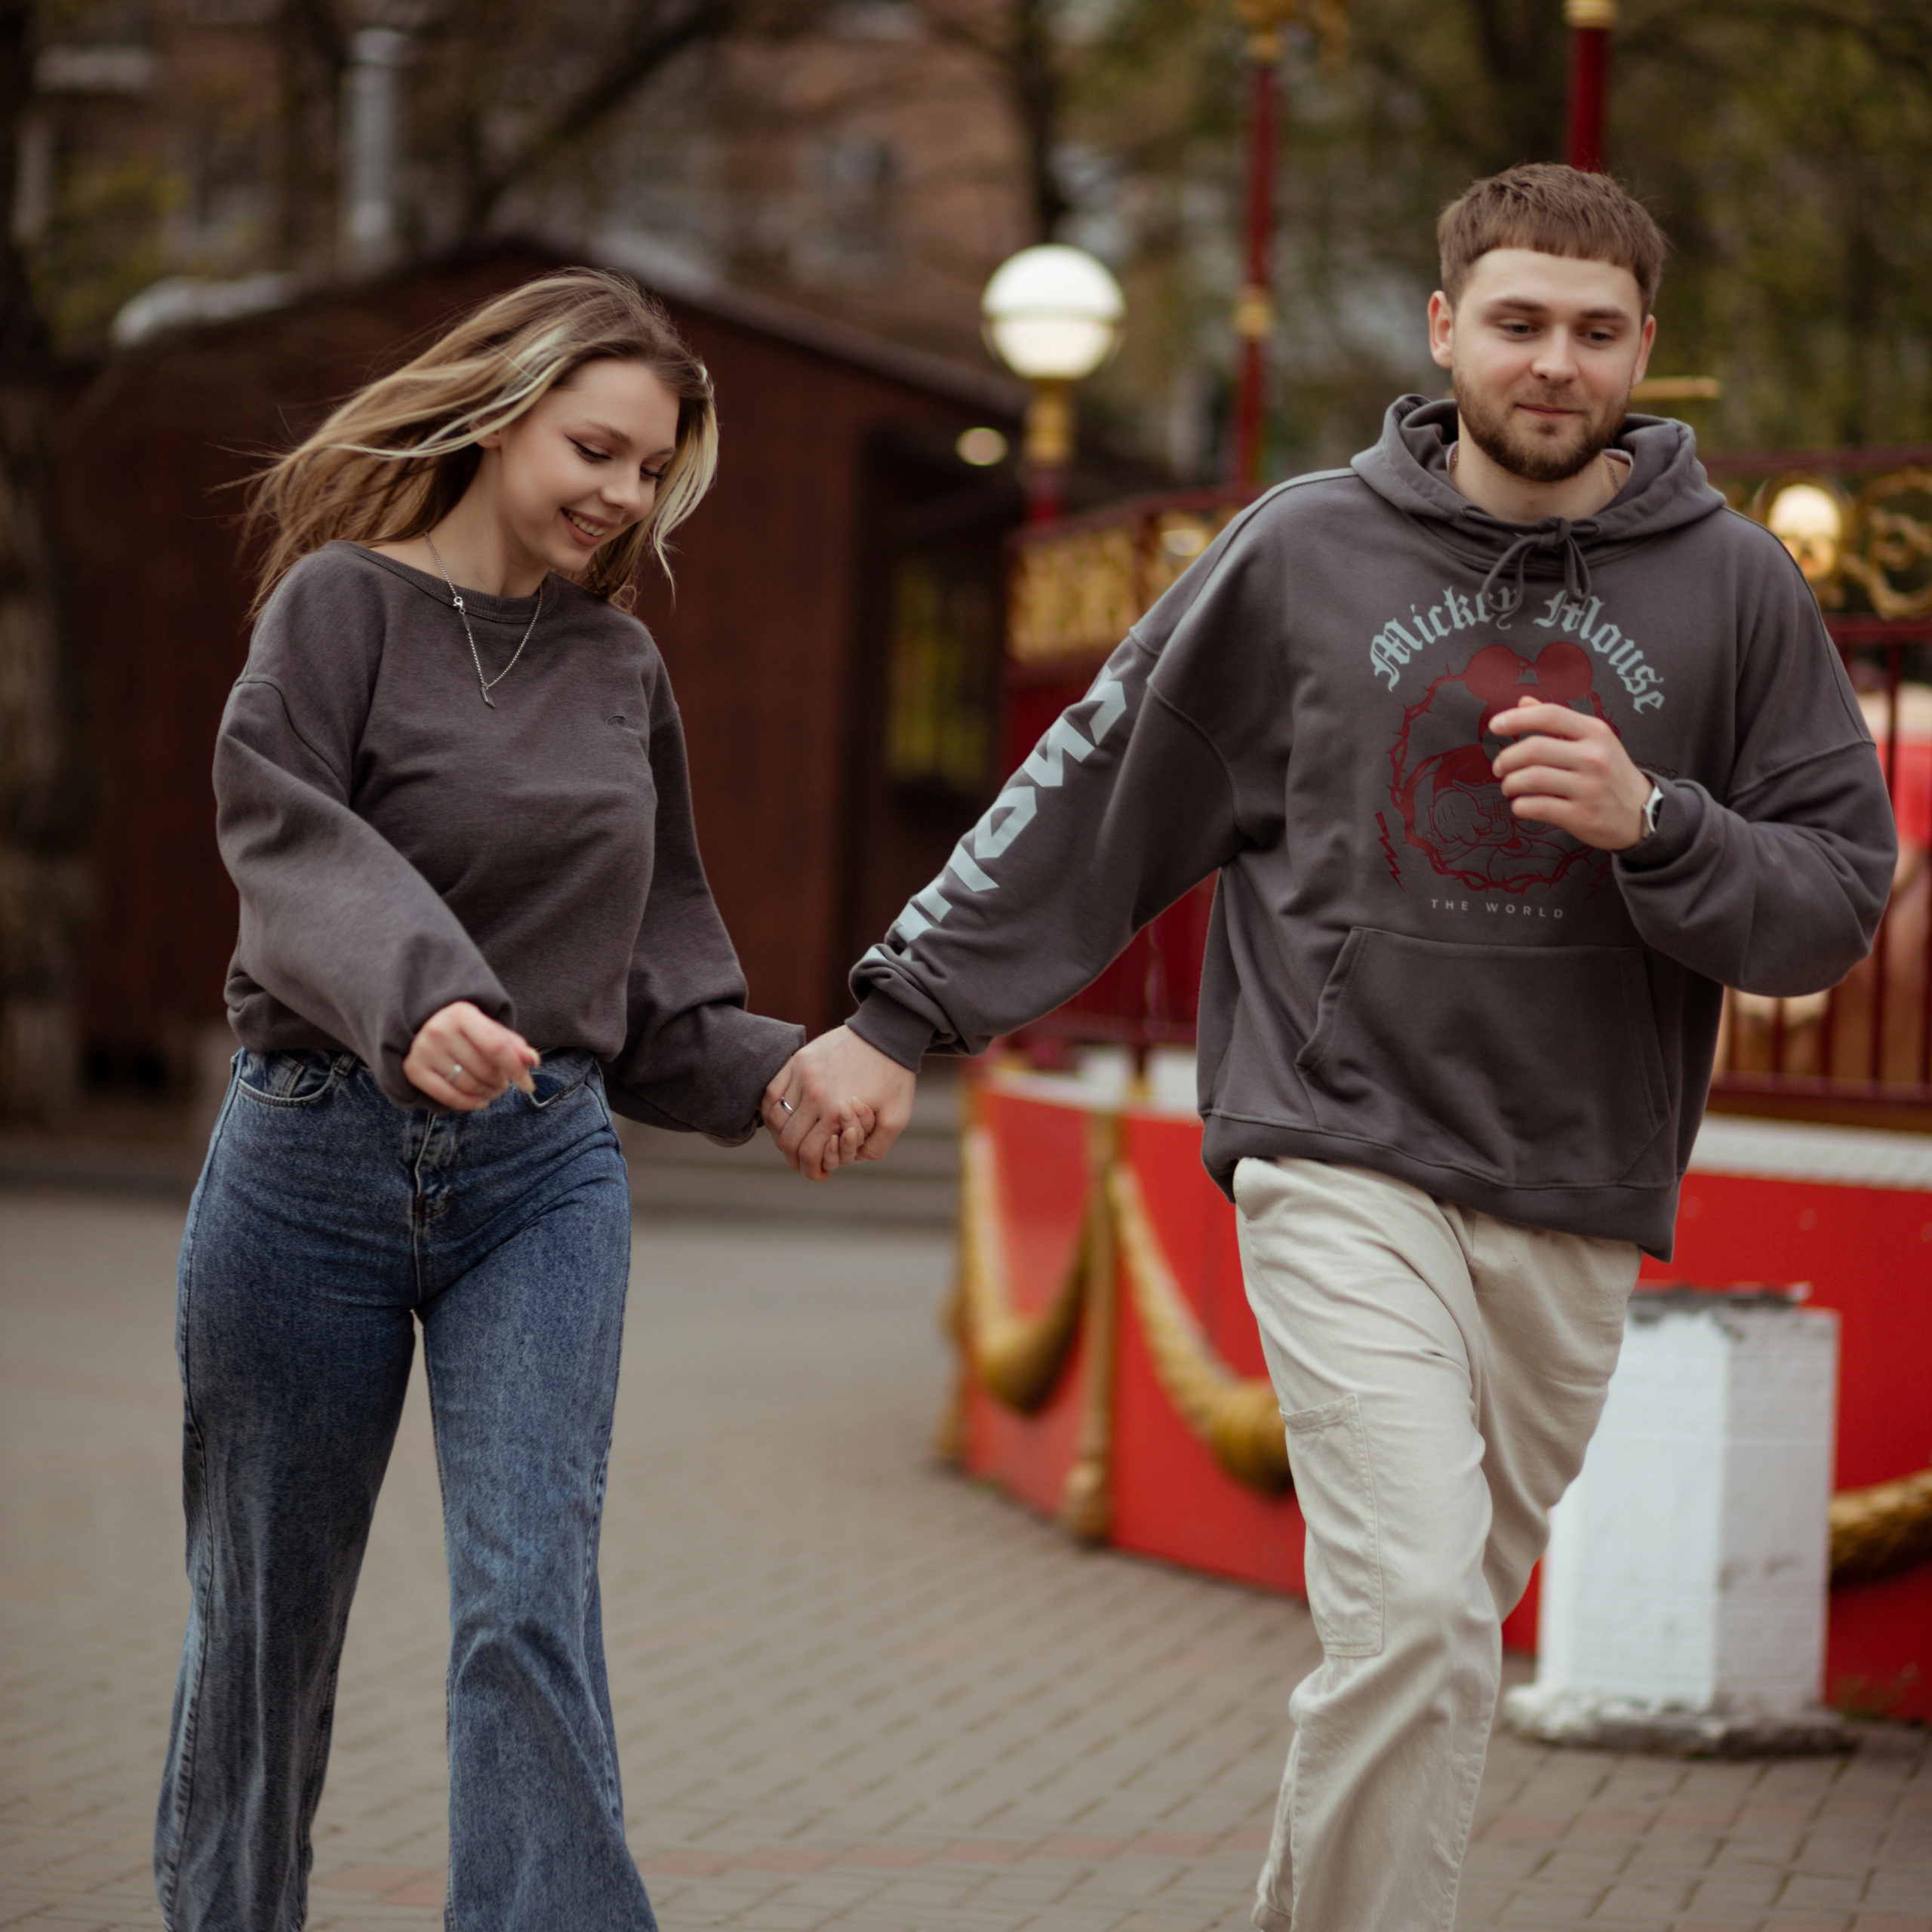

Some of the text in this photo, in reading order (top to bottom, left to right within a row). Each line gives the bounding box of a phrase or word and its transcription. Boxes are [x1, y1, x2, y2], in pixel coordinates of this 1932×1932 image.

[1370, 586, 1666, 715] Mickey Mouse
[1430, 899, 1563, 918] THE WORLD
